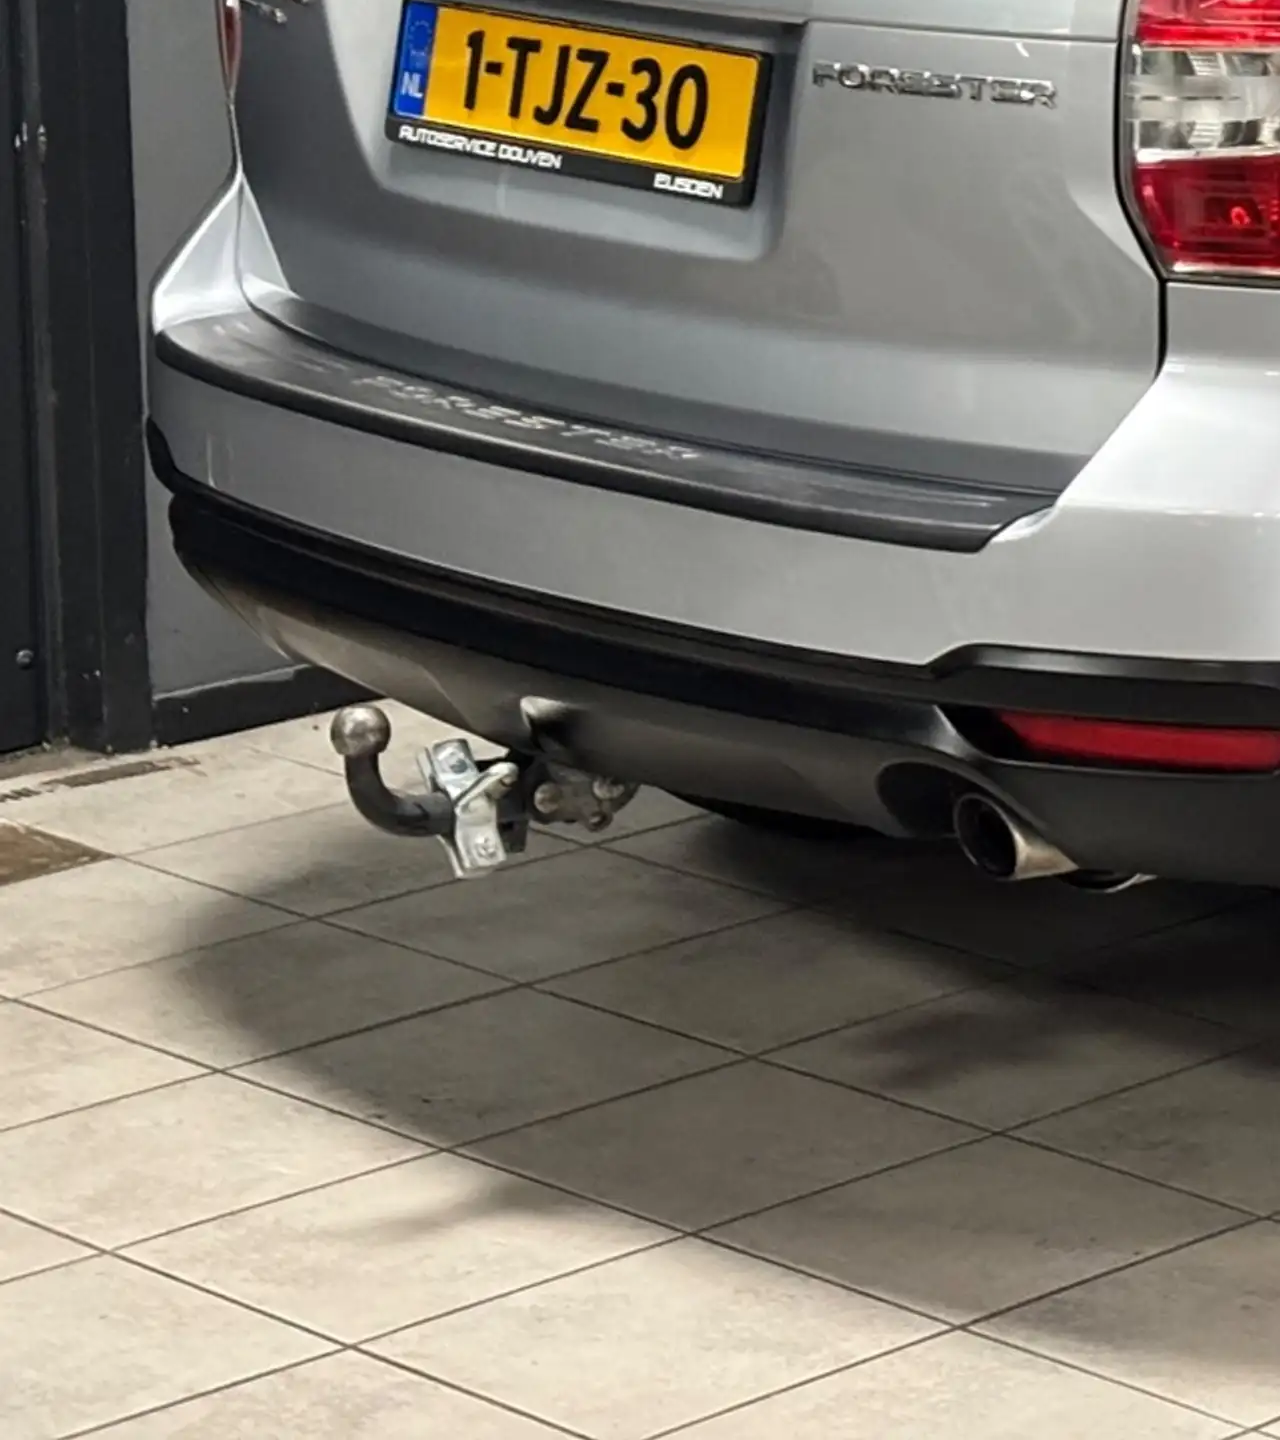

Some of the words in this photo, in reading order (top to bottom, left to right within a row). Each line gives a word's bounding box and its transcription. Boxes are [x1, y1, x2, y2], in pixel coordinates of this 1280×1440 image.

[400, 71, 424, 99] NL
[464, 29, 709, 151] 1-TJZ-30
[812, 60, 1058, 109] FORESTER
[398, 125, 497, 157] AUTOSERVICE
[498, 143, 563, 170] DOUVEN
[351, 375, 702, 461] FORESTER
